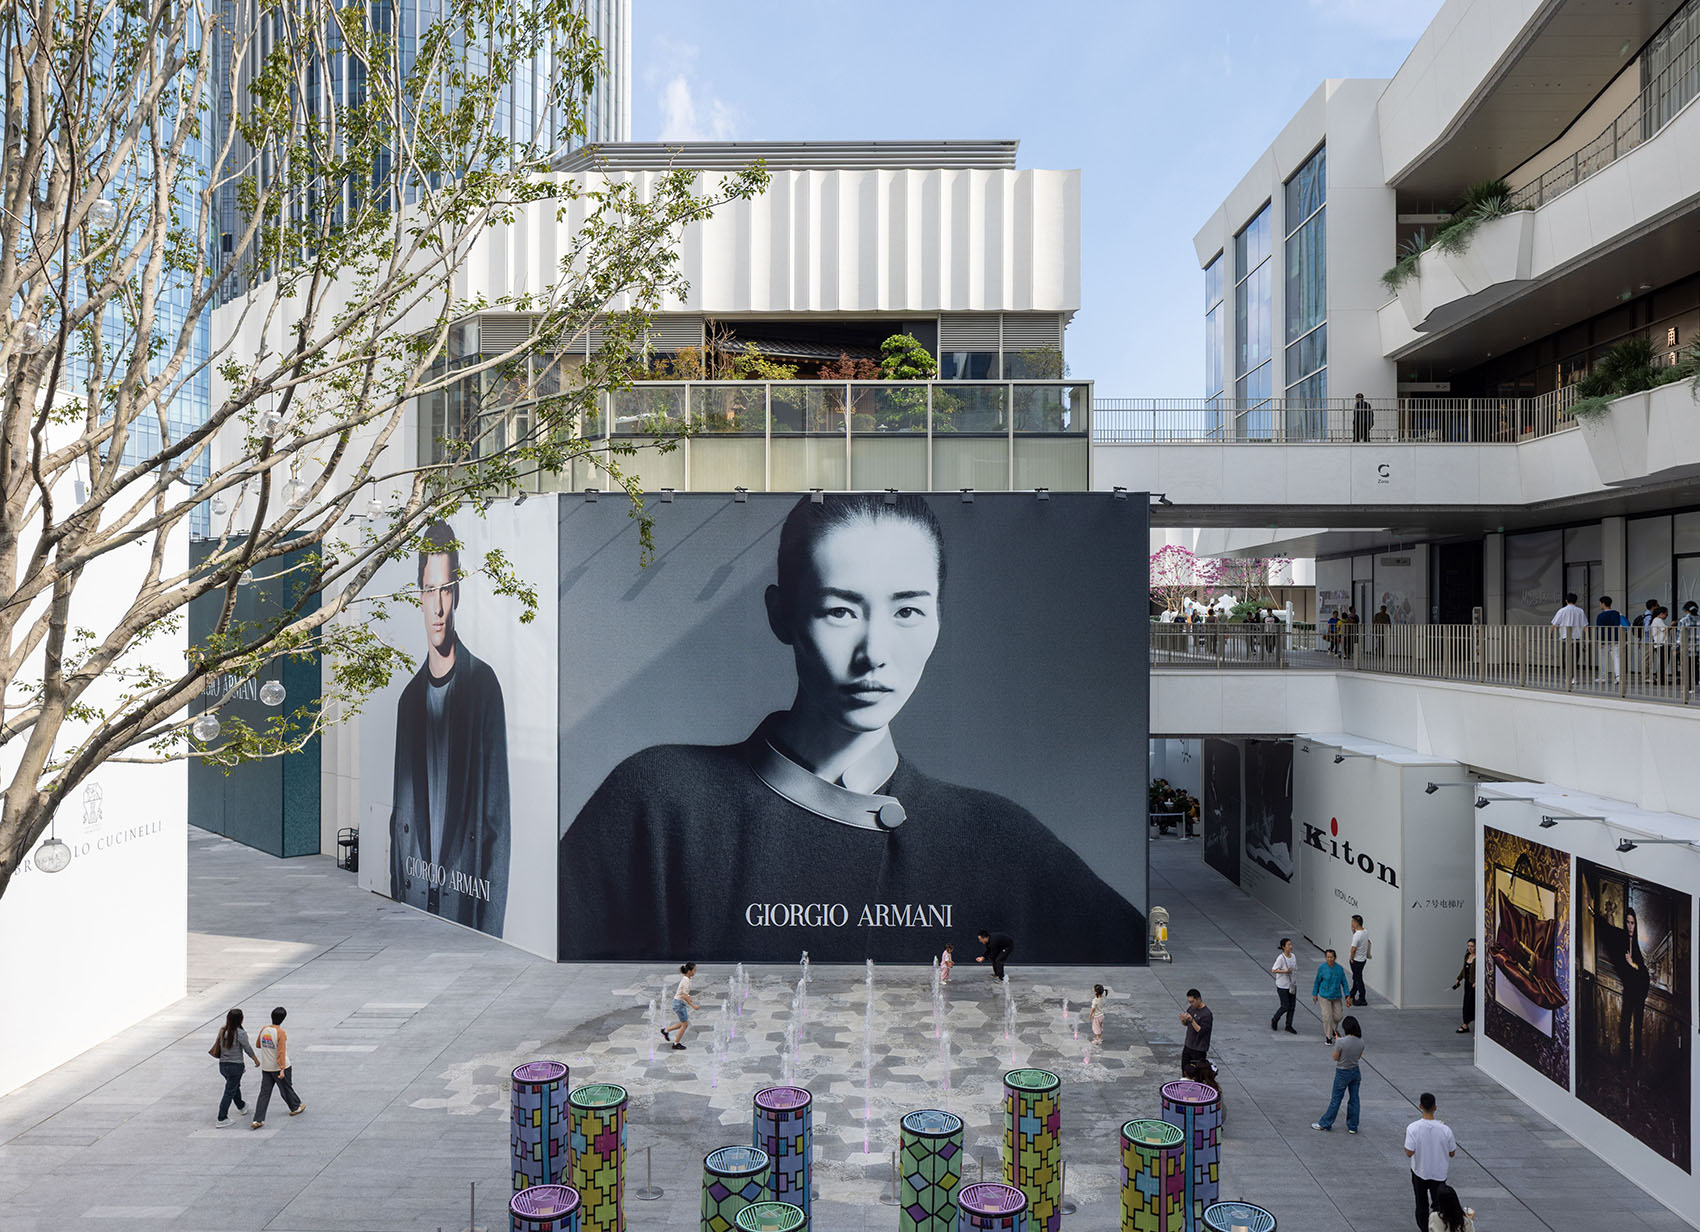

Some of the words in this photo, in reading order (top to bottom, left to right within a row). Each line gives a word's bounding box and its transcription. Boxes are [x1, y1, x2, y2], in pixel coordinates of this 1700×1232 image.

[1377, 463, 1390, 478] C
[97, 820, 162, 851] CUCINELLI
[1303, 816, 1400, 889] Kiton
[405, 855, 446, 887] GIORGIO
[448, 869, 491, 902] ARMANI
[745, 902, 849, 927] GIORGIO
[857, 903, 953, 927] ARMANI
